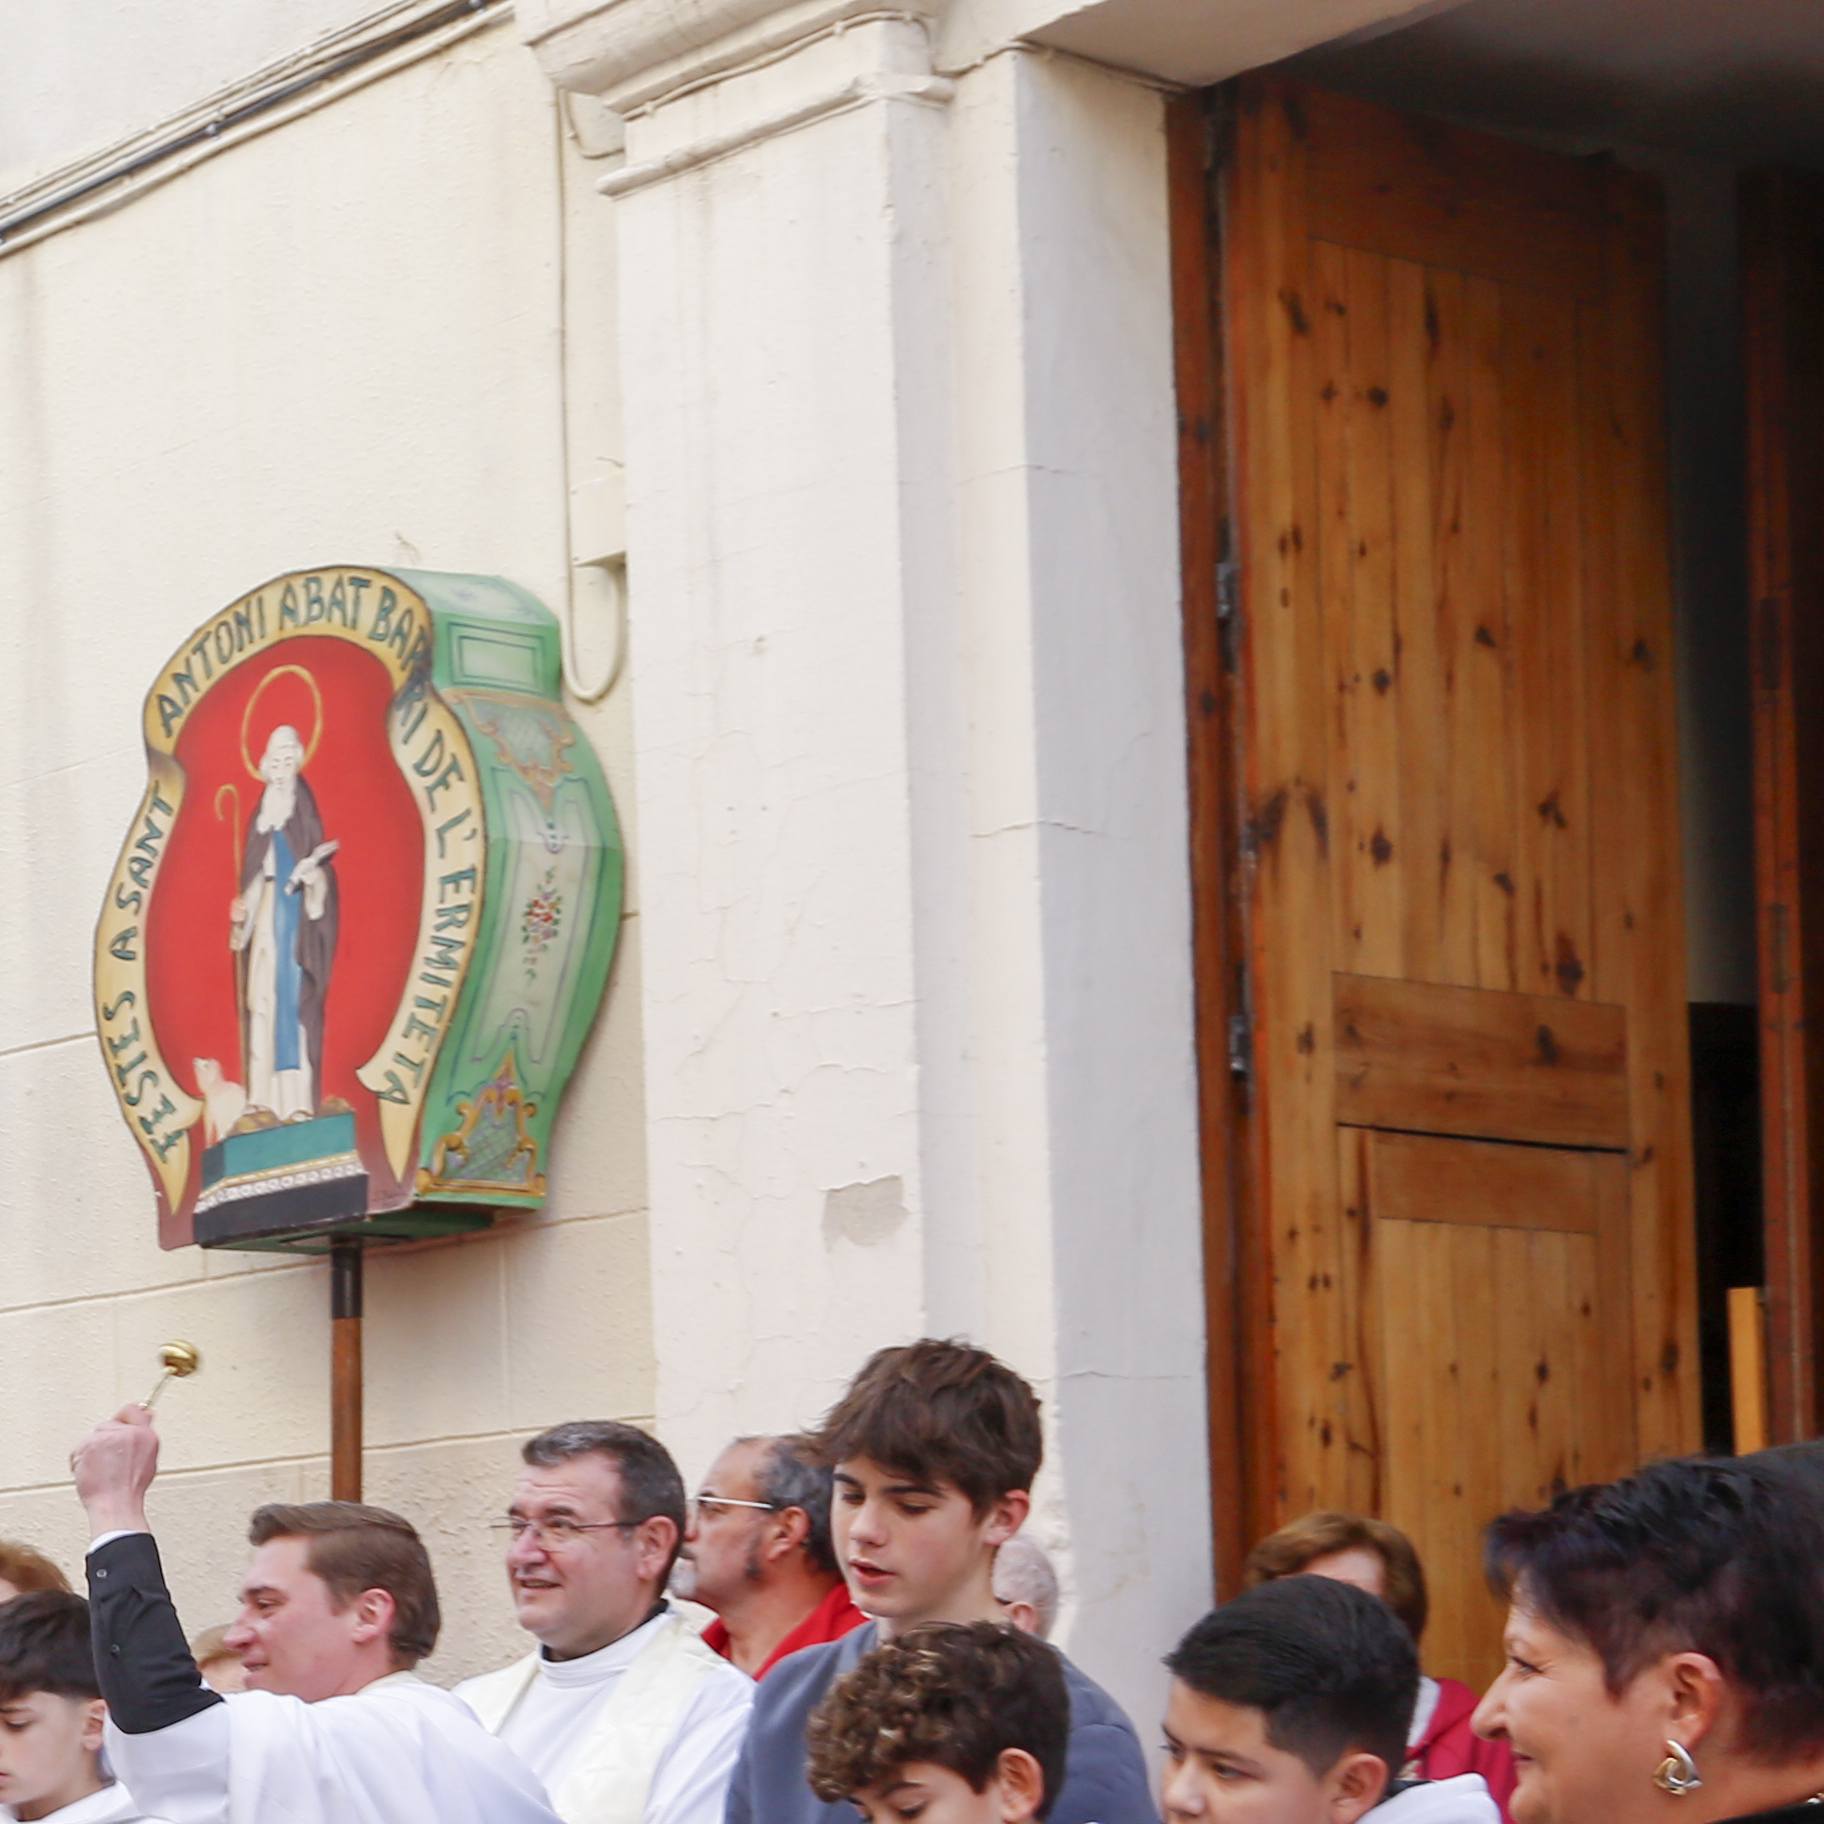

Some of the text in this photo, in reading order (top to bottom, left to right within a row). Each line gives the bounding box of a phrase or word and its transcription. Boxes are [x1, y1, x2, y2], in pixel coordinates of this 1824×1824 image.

[278, 572, 372, 631] ABAT
[156, 595, 266, 738] ANTONI
[414, 728, 464, 812] DE
[116, 780, 174, 916] SANT
[109, 926, 137, 961] A
[103, 990, 184, 1163] FESTES
